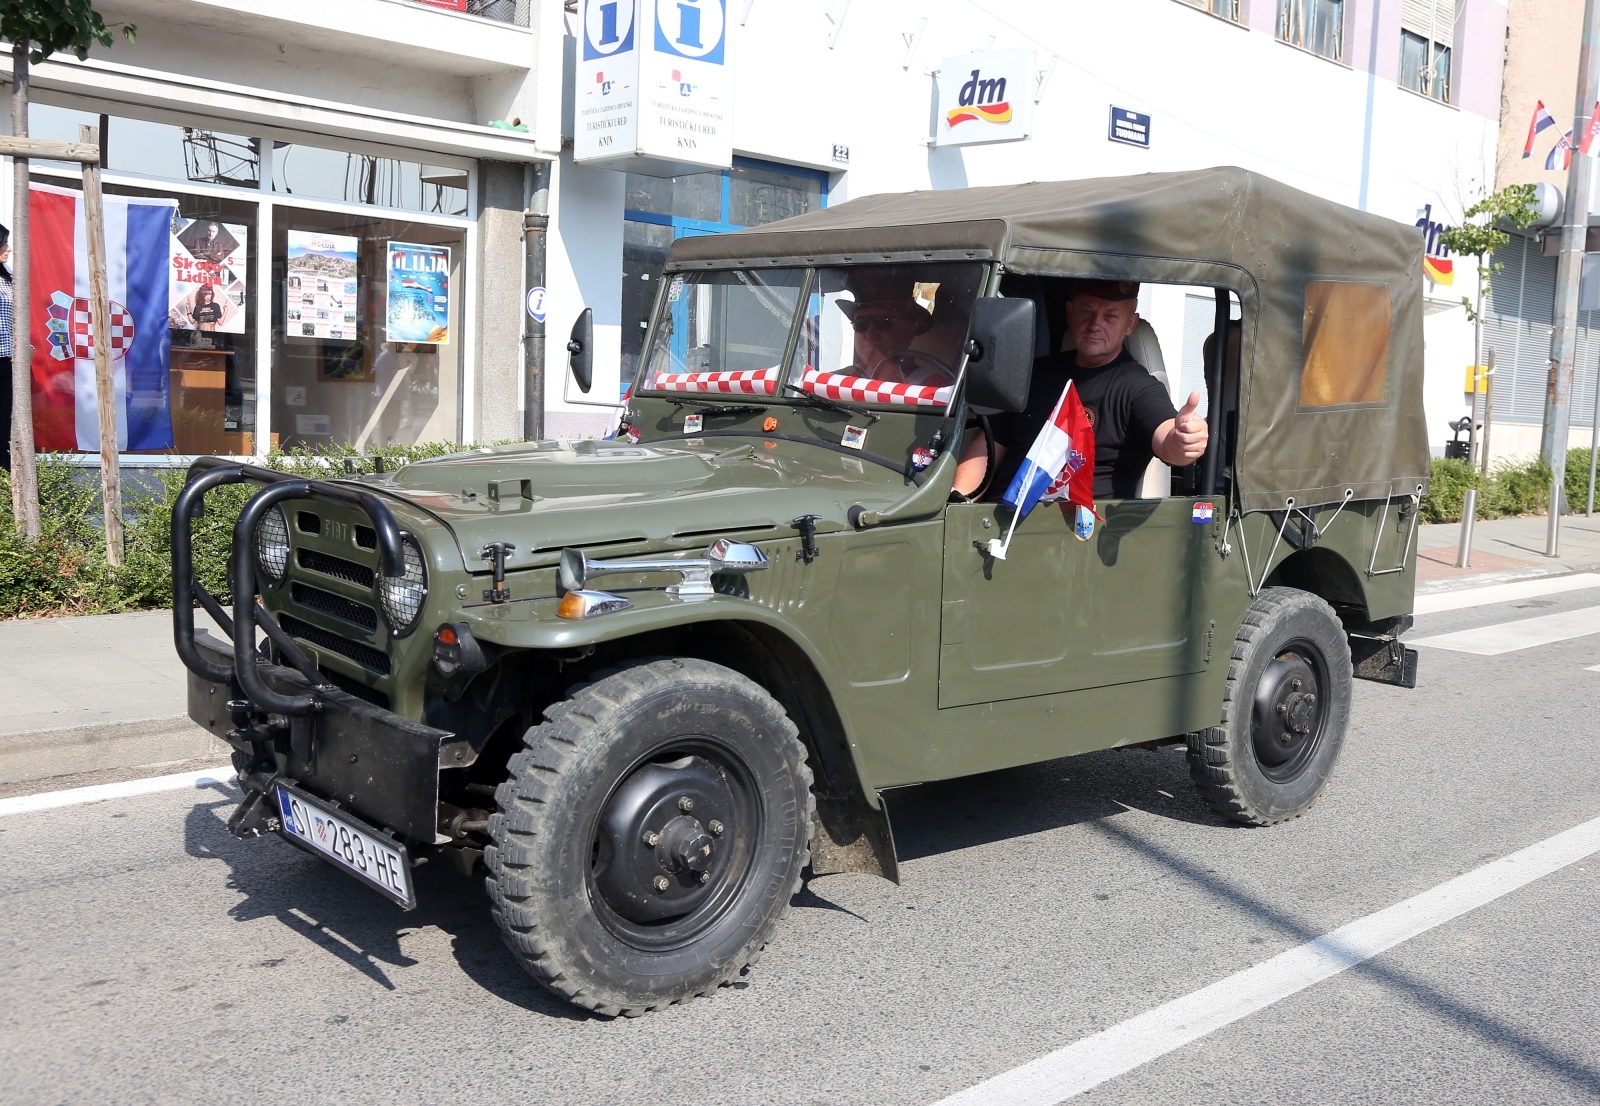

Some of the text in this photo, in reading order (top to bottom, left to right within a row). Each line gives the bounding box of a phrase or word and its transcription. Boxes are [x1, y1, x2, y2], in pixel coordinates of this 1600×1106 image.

[958, 69, 1007, 107] dm
[659, 116, 697, 132] TURISTIČKI
[598, 135, 614, 148] KNIN
[677, 136, 698, 149] KNIN
[834, 145, 848, 158] 22
[172, 252, 223, 273] Škoro
[176, 269, 223, 288] Lidija
[325, 519, 348, 542] FIAT
[291, 799, 403, 893] SI 283-HE
